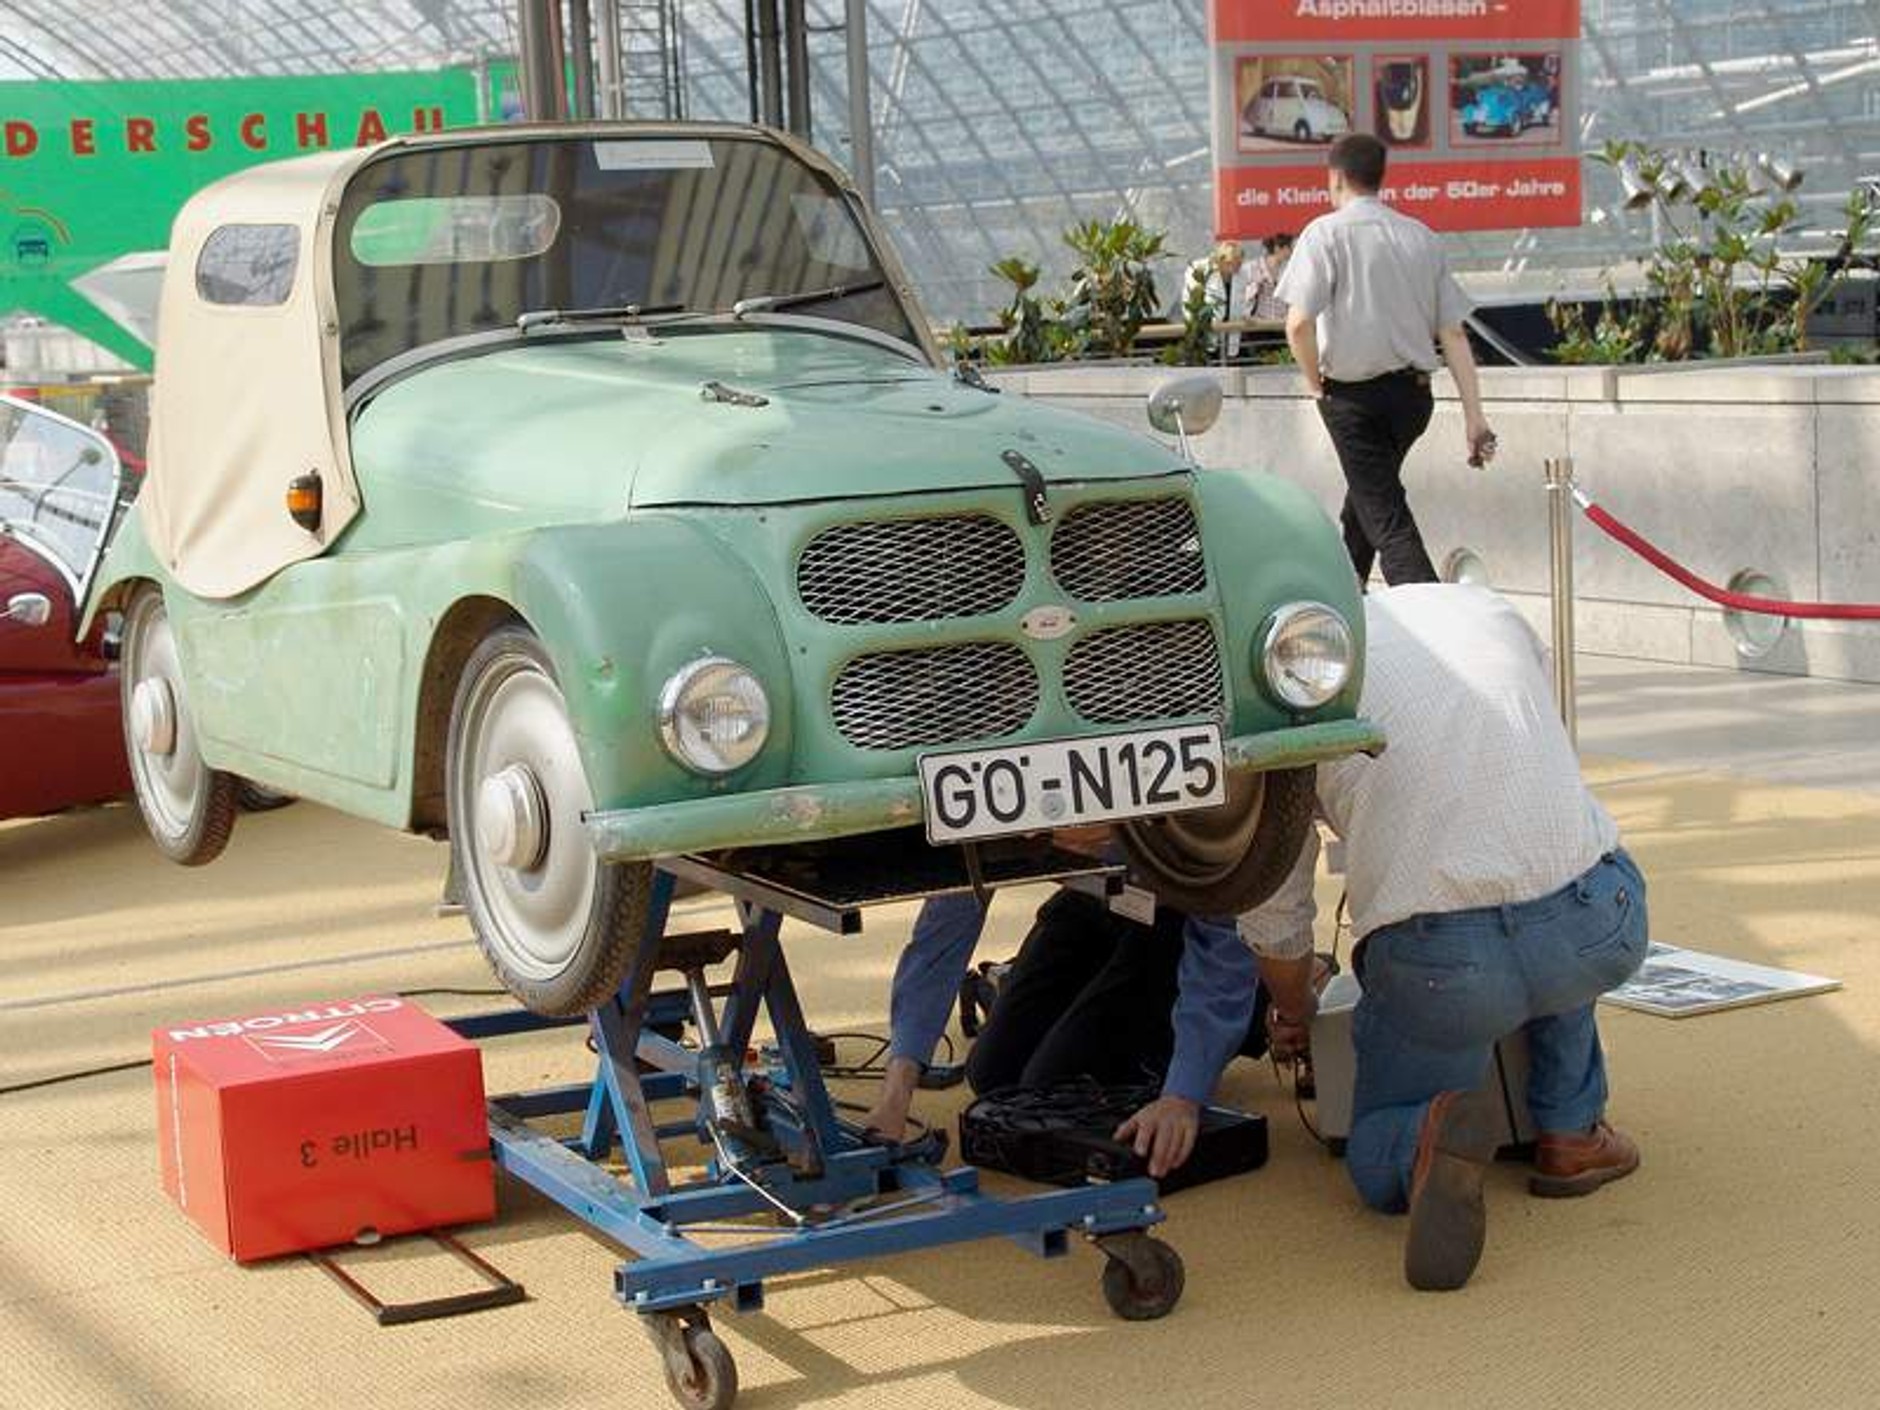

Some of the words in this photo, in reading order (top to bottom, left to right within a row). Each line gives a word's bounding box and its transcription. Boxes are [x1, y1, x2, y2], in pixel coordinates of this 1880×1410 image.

[4, 107, 443, 158] DERSCHAU
[1237, 187, 1270, 206] die
[1403, 182, 1440, 201] der
[1506, 177, 1566, 198] Jahre
[168, 997, 404, 1043] CITROËN
[299, 1138, 319, 1169] 3
[331, 1123, 418, 1160] Halle
